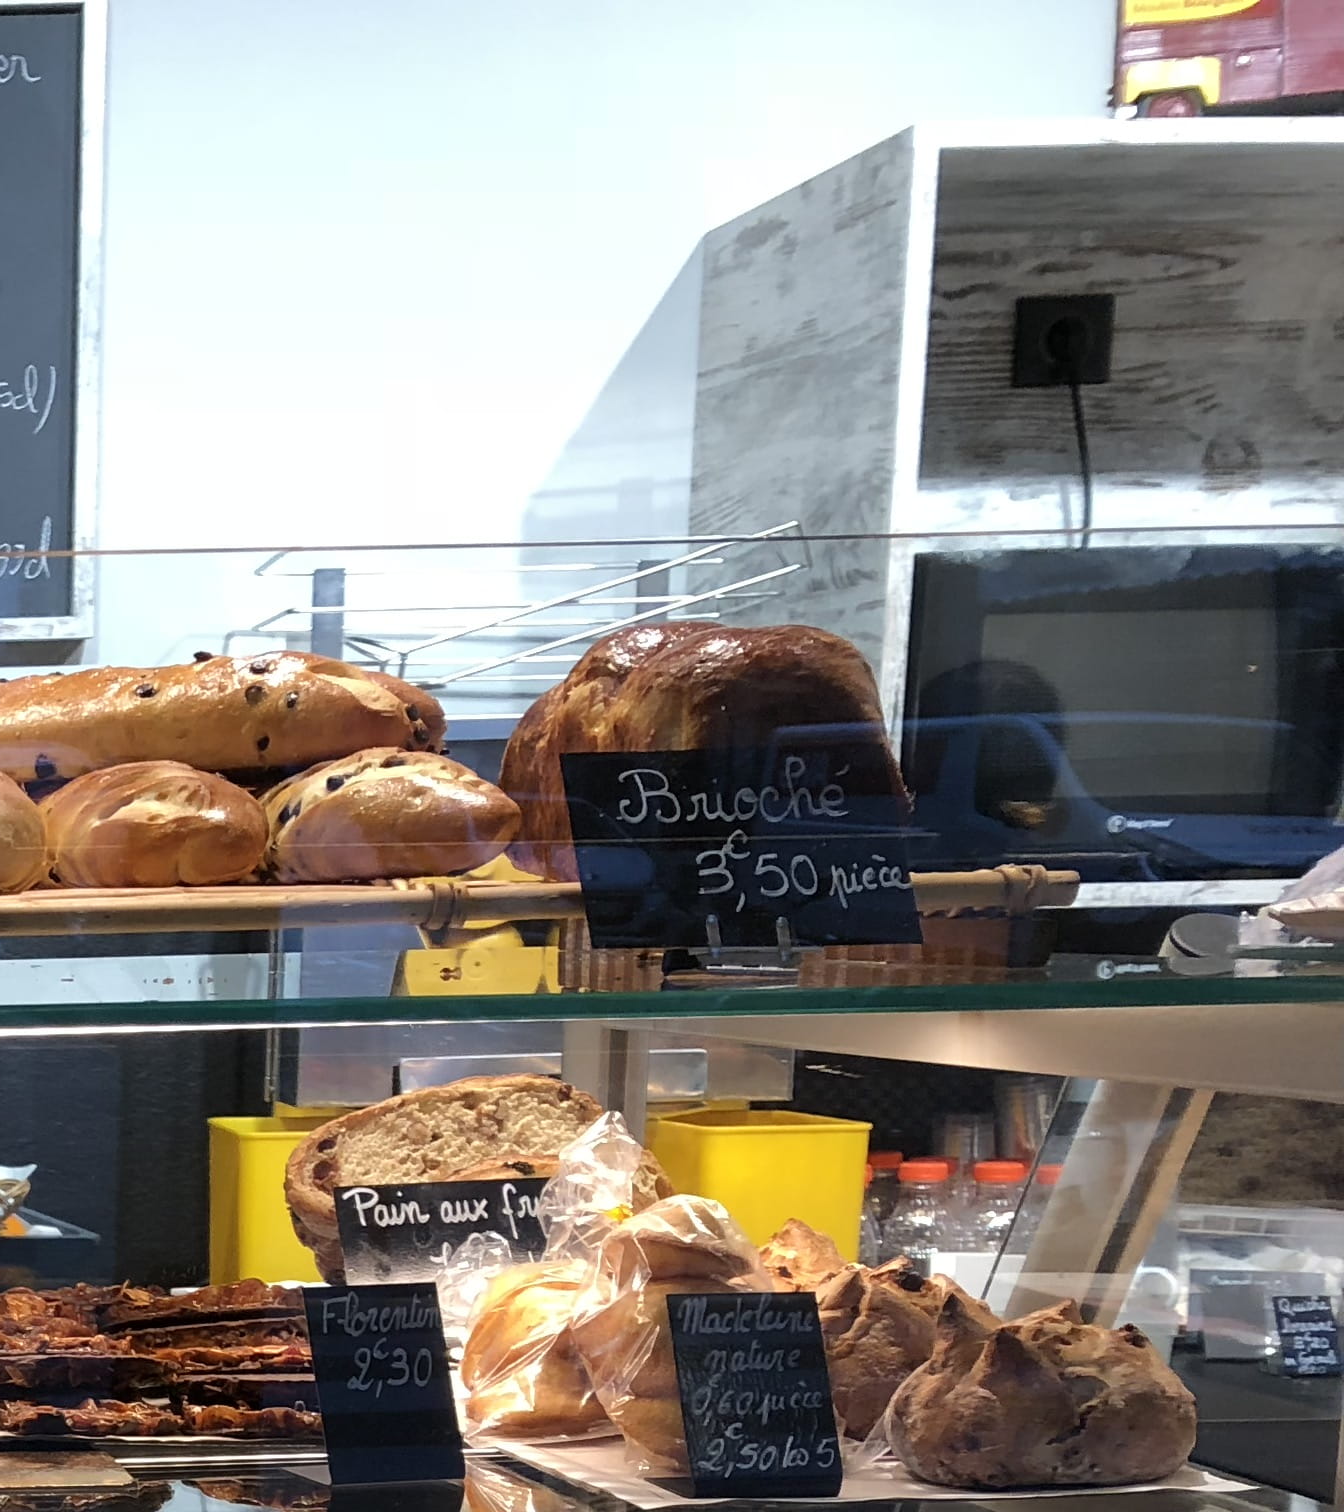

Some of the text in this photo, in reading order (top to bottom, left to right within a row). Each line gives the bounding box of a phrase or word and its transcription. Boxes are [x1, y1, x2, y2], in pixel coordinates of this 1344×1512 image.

[829, 854, 910, 908] pièce
[342, 1188, 428, 1228] Pain
[440, 1194, 488, 1221] aux
[320, 1294, 440, 1335] Florentin
[678, 1294, 813, 1334] Madeleine
[704, 1340, 801, 1372] nature
[817, 1438, 836, 1468] 5
